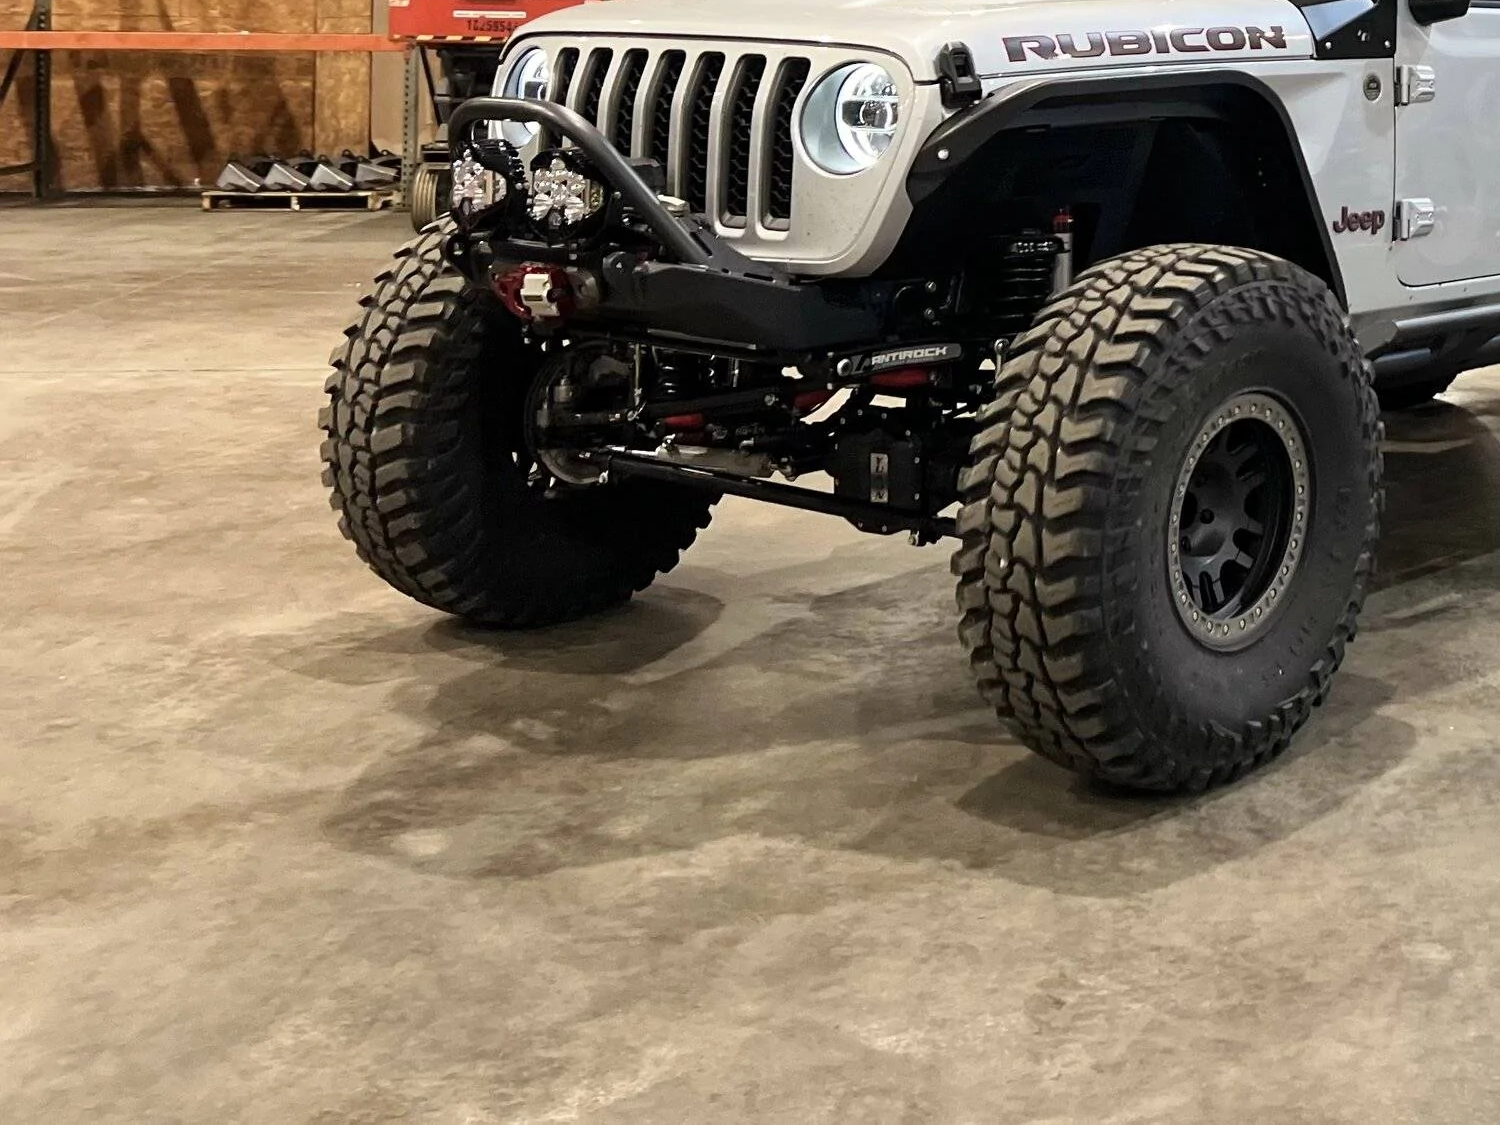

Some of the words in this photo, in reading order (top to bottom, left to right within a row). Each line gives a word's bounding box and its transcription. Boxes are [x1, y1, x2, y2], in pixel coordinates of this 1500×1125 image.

[1002, 25, 1287, 63] RUBICON
[1333, 206, 1385, 235] Jeep
[872, 346, 947, 365] ANTIROCK
